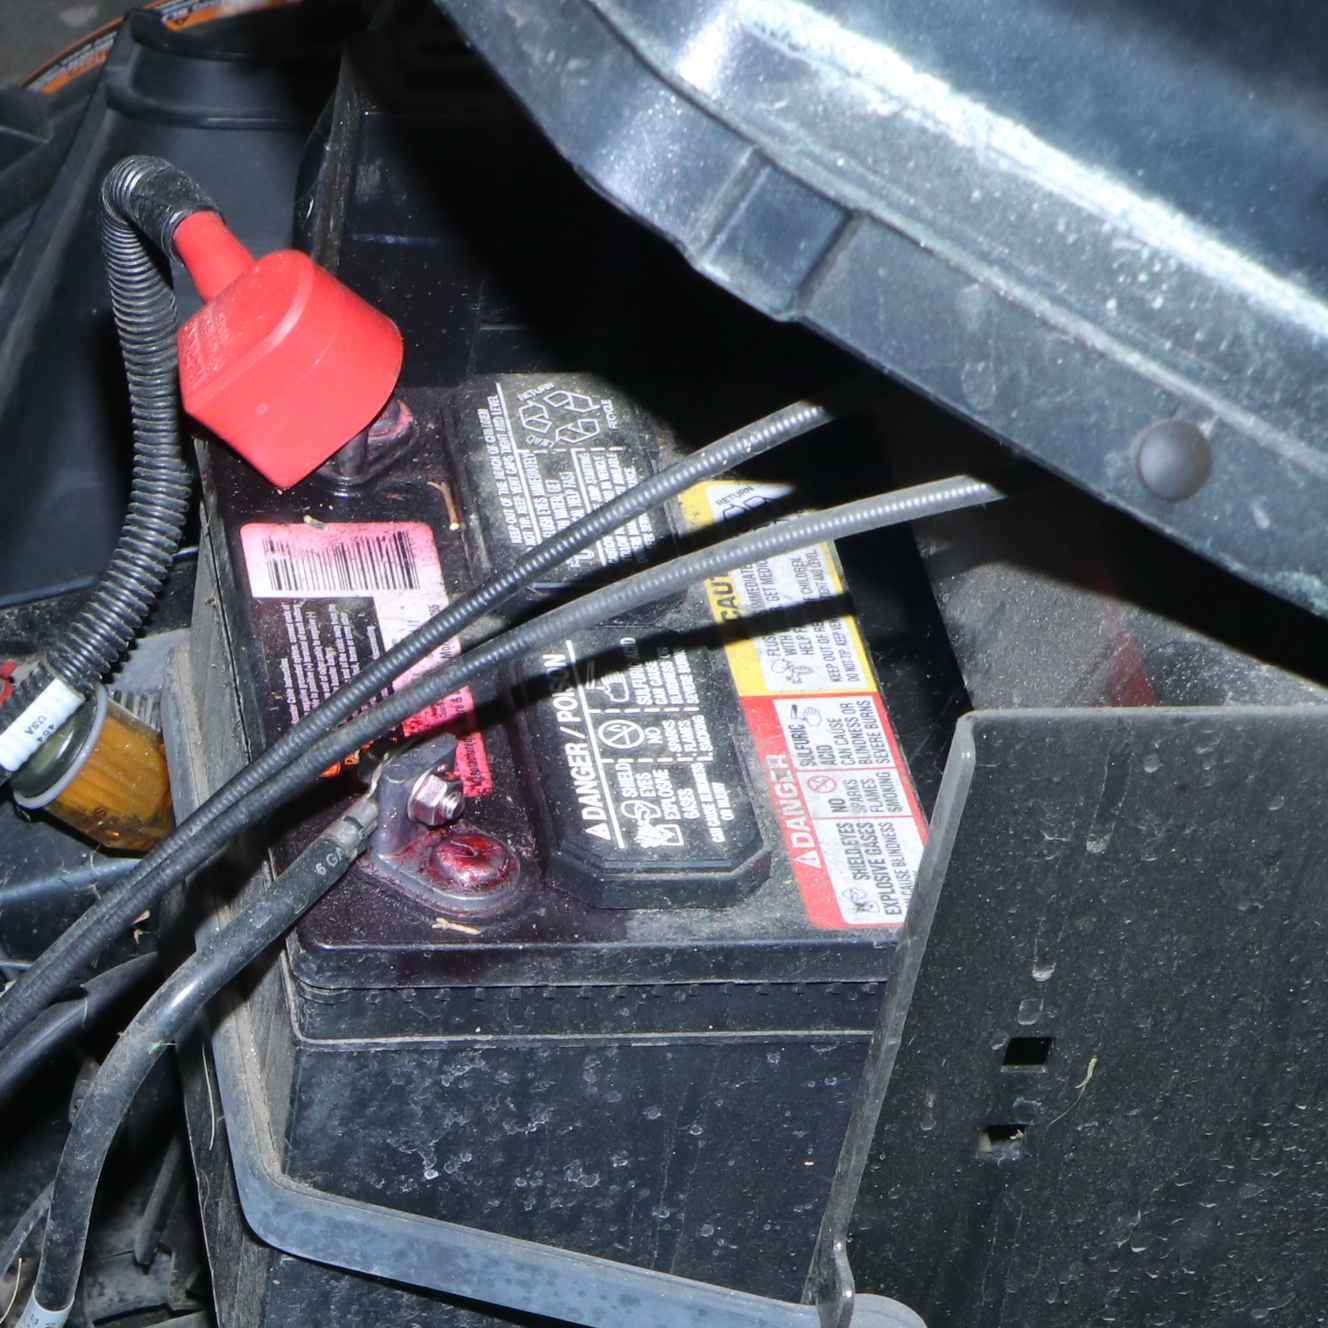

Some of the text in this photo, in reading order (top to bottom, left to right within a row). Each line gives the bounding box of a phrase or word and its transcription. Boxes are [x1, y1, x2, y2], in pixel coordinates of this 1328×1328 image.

[517, 382, 555, 402] RETURN
[490, 456, 506, 480] REACH
[496, 481, 510, 495] THE
[500, 497, 513, 508] OF
[715, 486, 755, 506] RETURN
[502, 508, 517, 524] OUT
[508, 525, 522, 544] KEEP
[645, 726, 662, 743] NO
[789, 724, 816, 766] SULFURIC
[827, 718, 855, 765] CAN CAUSE
[839, 702, 872, 764] BLINDNESS OR
[856, 700, 890, 763] SEVERE BURNS
[816, 744, 836, 765] ACID
[565, 743, 606, 819] DANGER
[616, 762, 637, 797] SHIELD
[635, 772, 655, 796] EYES
[653, 769, 680, 819] EXPLOSIVE
[861, 778, 883, 812] FLAMES
[876, 771, 902, 812] SMOKING
[678, 788, 699, 818] GASES
[766, 754, 814, 847] DANGER
[829, 798, 847, 812] NO
[836, 822, 870, 880] SHIELD EYES
[857, 822, 901, 914] EXPLOSIVE GASES
